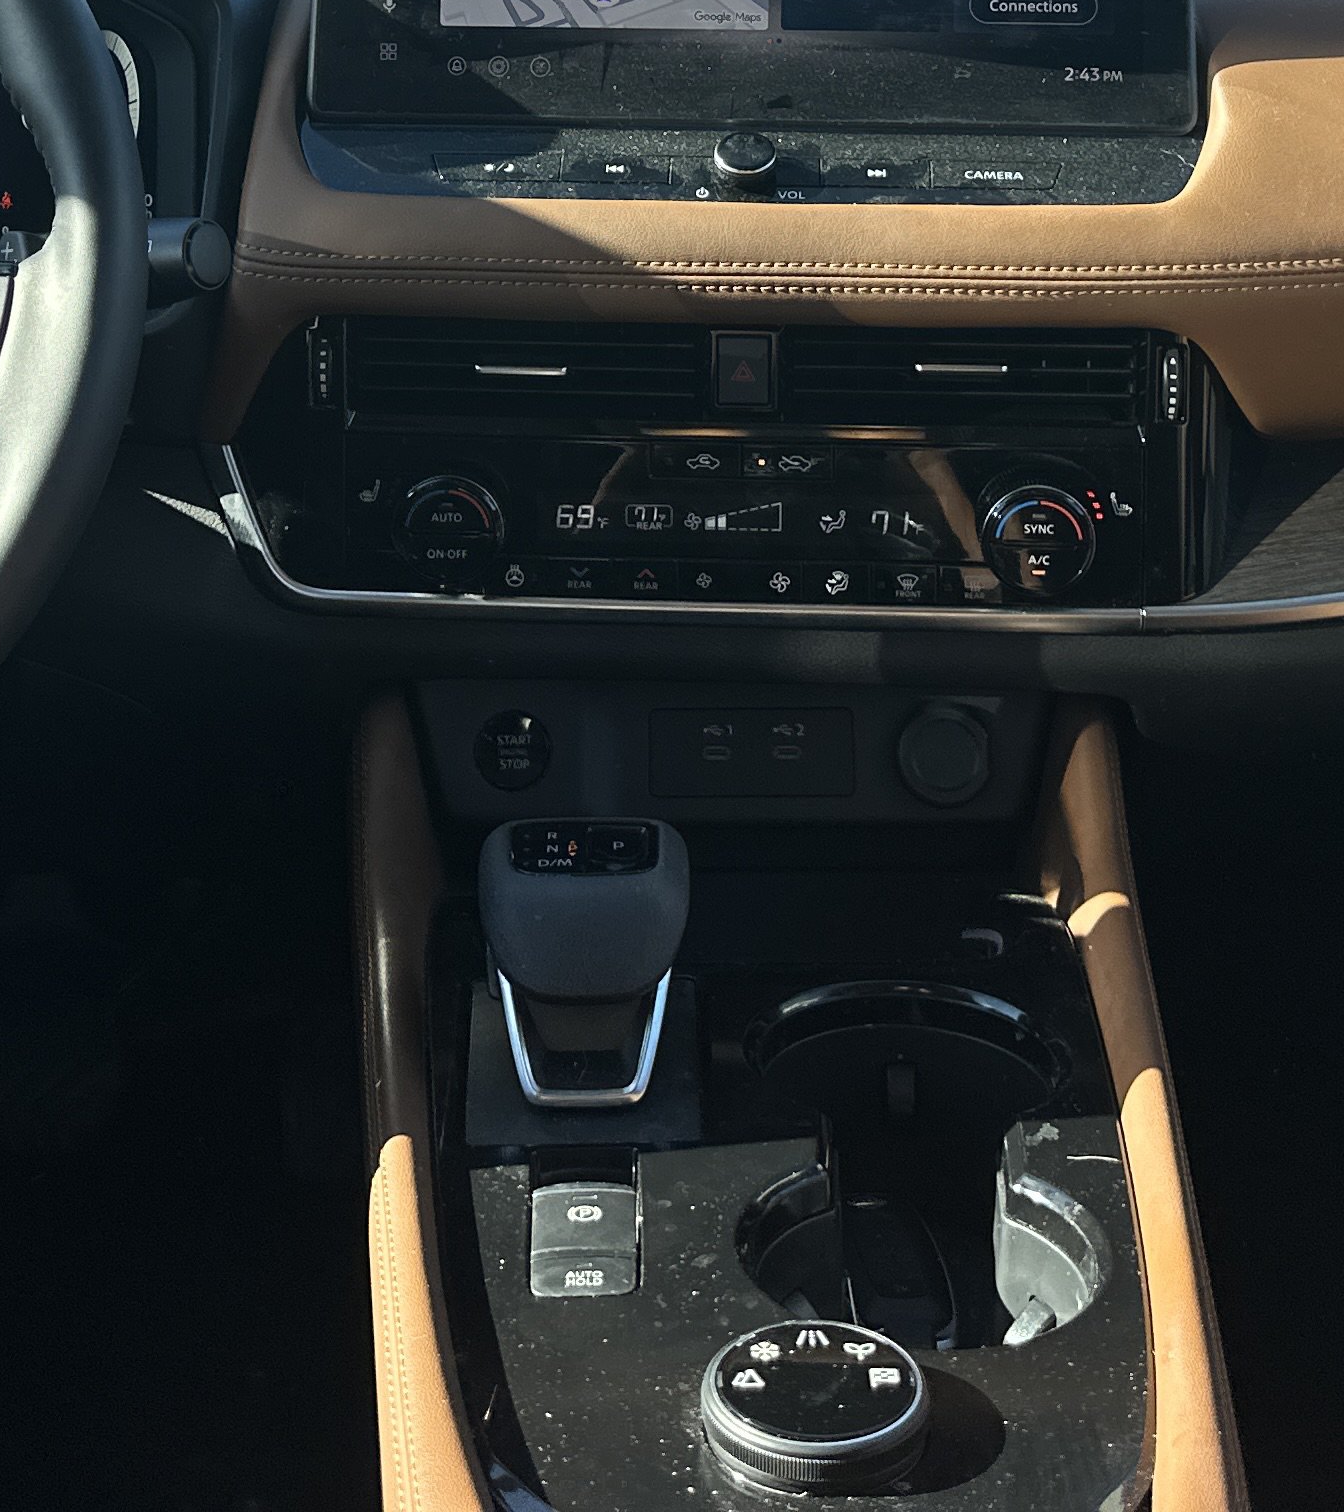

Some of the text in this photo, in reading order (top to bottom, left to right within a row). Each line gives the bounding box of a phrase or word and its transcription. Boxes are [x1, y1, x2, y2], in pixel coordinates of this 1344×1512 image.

[989, 0, 1078, 13] Connections
[694, 10, 762, 24] Google Maps
[1064, 67, 1124, 82] 2:43 PM
[964, 170, 1023, 181] CAMERA
[778, 190, 805, 200] VOL
[431, 512, 463, 522] AUTO
[636, 521, 662, 530] REAR
[1023, 523, 1054, 535] SYNC
[1028, 554, 1050, 565] A/C
[497, 734, 531, 745] START
[499, 758, 530, 769] STOP
[546, 845, 559, 853] N
[613, 841, 625, 850] P
[538, 858, 573, 867] D/M
[565, 1270, 604, 1278] AUTO
[564, 1277, 604, 1287] HOLD
